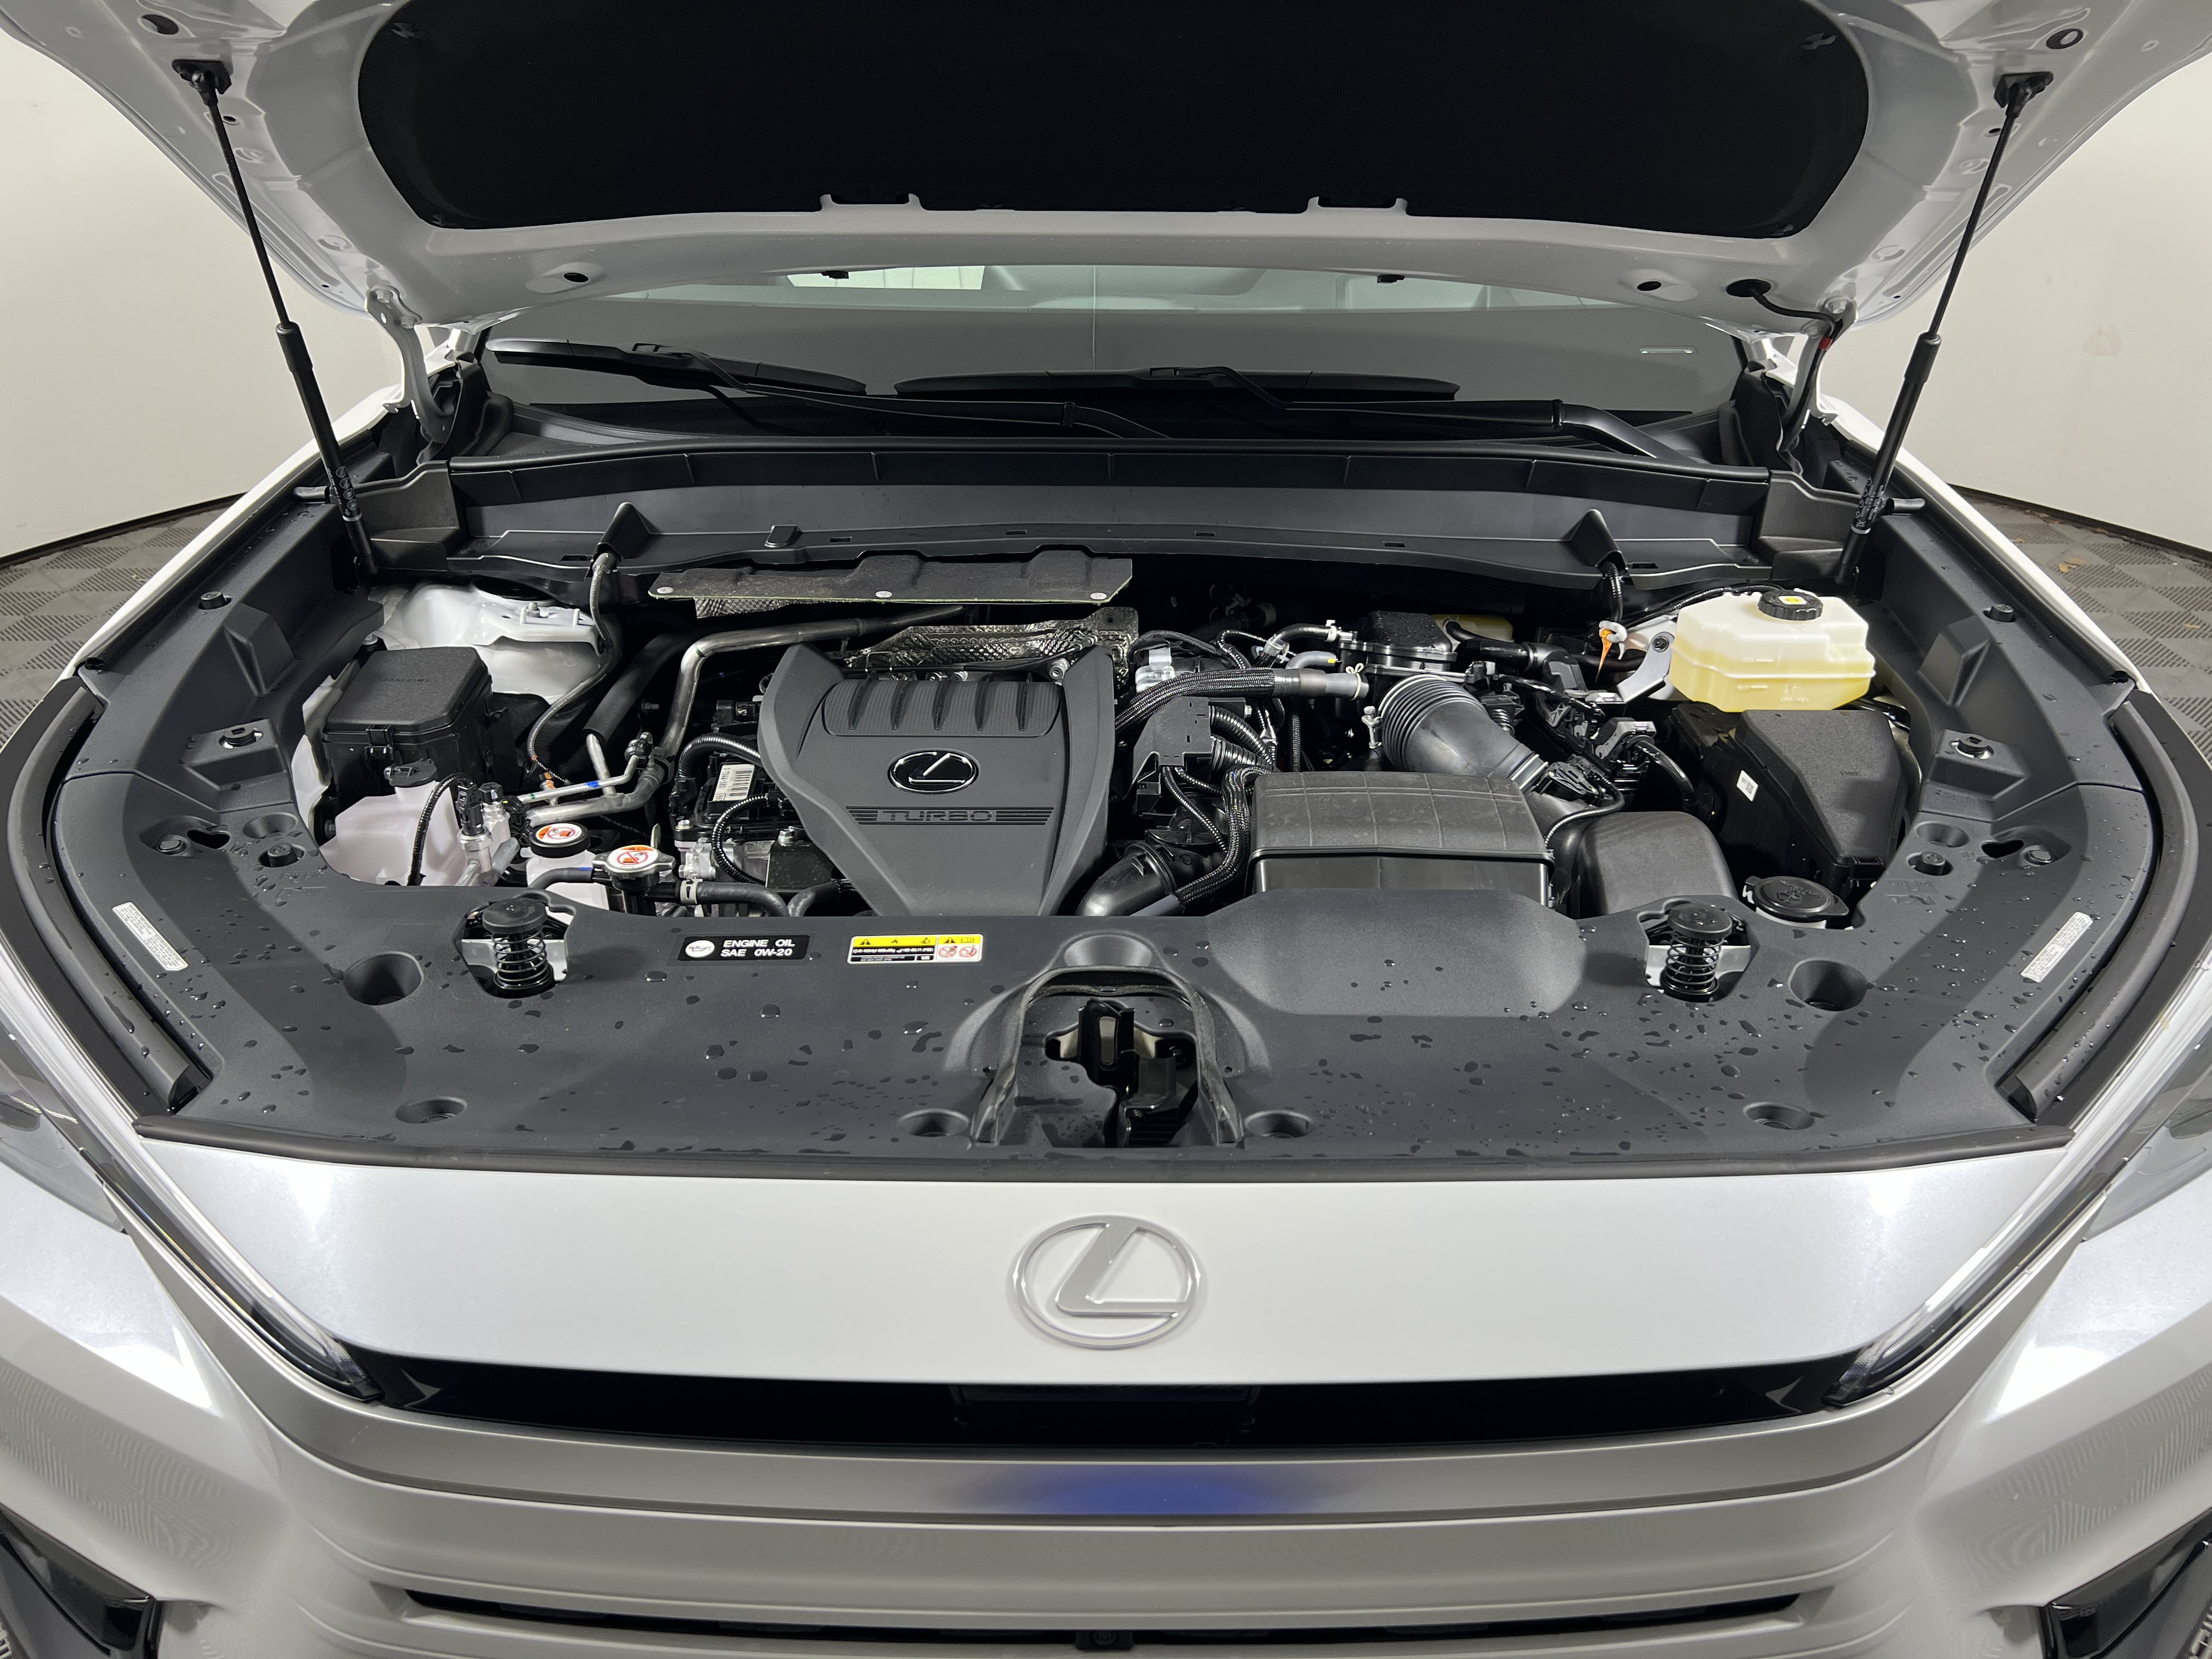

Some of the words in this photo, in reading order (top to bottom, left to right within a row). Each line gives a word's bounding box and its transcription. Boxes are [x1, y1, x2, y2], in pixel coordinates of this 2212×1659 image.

[882, 810, 992, 821] TURBO
[723, 939, 769, 948] ENGINE
[775, 939, 795, 947] OIL
[720, 949, 747, 957] SAE
[754, 948, 793, 957] 0W-20
